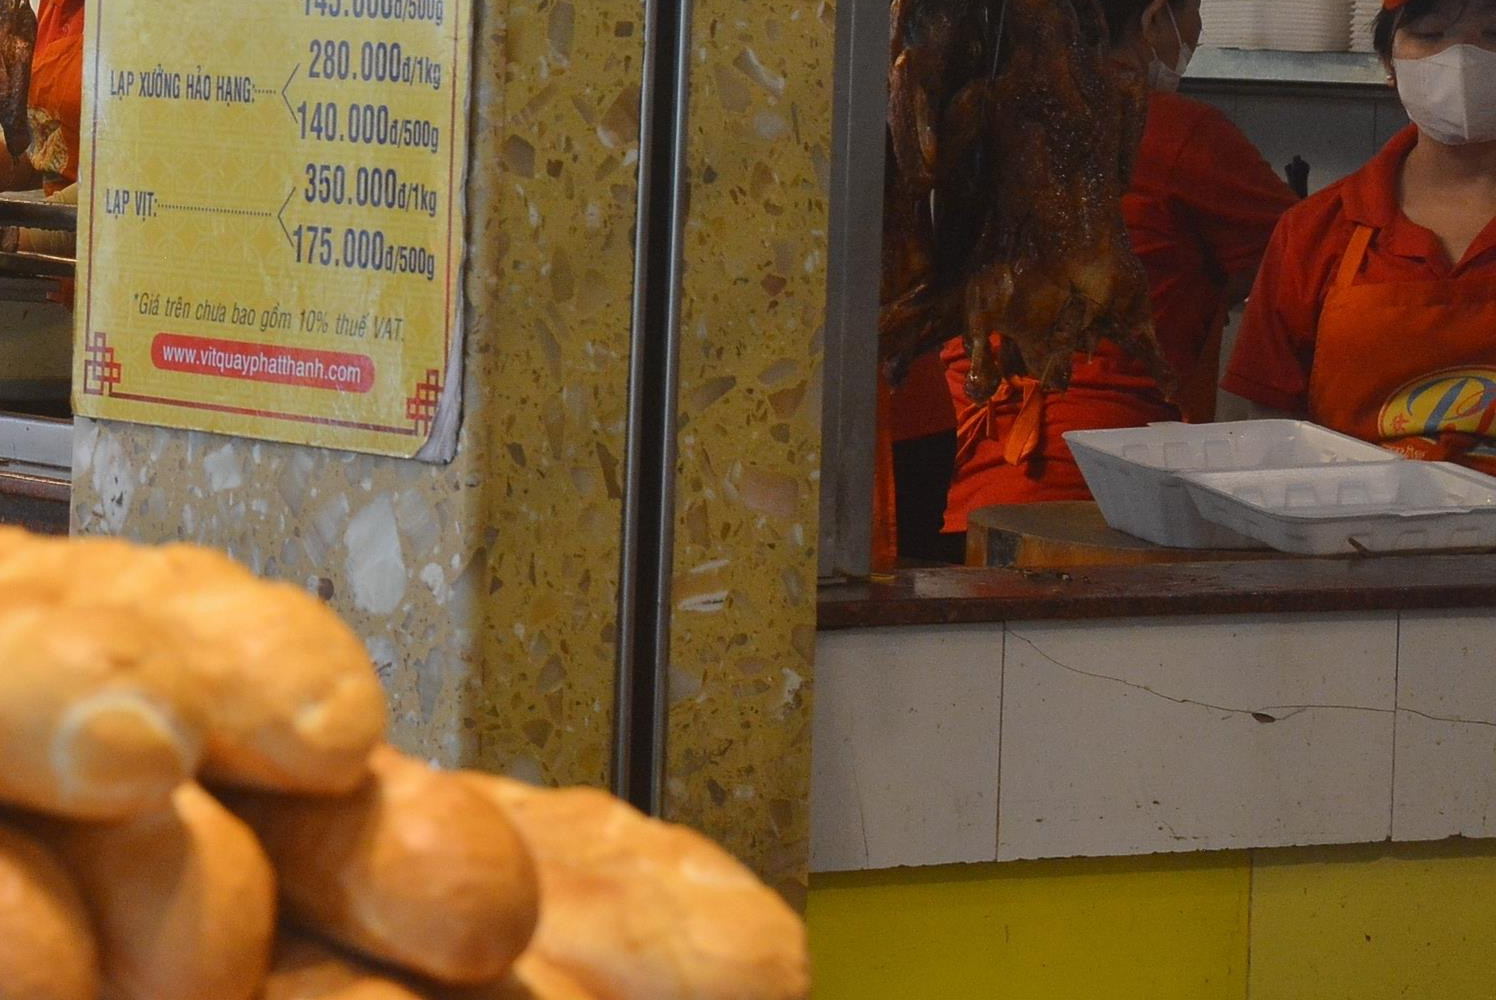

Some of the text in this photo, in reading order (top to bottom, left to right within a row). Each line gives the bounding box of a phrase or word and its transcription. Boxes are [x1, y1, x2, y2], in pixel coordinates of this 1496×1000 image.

[110, 70, 134, 101] LẠP
[138, 64, 181, 99] XƯỞNG
[186, 65, 211, 101] HẢO
[308, 39, 442, 91] 280.000đ/1kg
[297, 101, 440, 154] 140.000đ/500g
[106, 188, 130, 220] LẠP
[304, 162, 437, 218] 350.000đ/1kg
[293, 224, 435, 281] 175.000đ/500g
[164, 295, 191, 319] trên
[195, 299, 226, 323] chưa
[231, 302, 256, 327] bao
[260, 302, 292, 332] gồm
[298, 309, 329, 334] 10%
[335, 312, 370, 338] thuế
[162, 342, 361, 384] www.vitquayphatthanh.com
